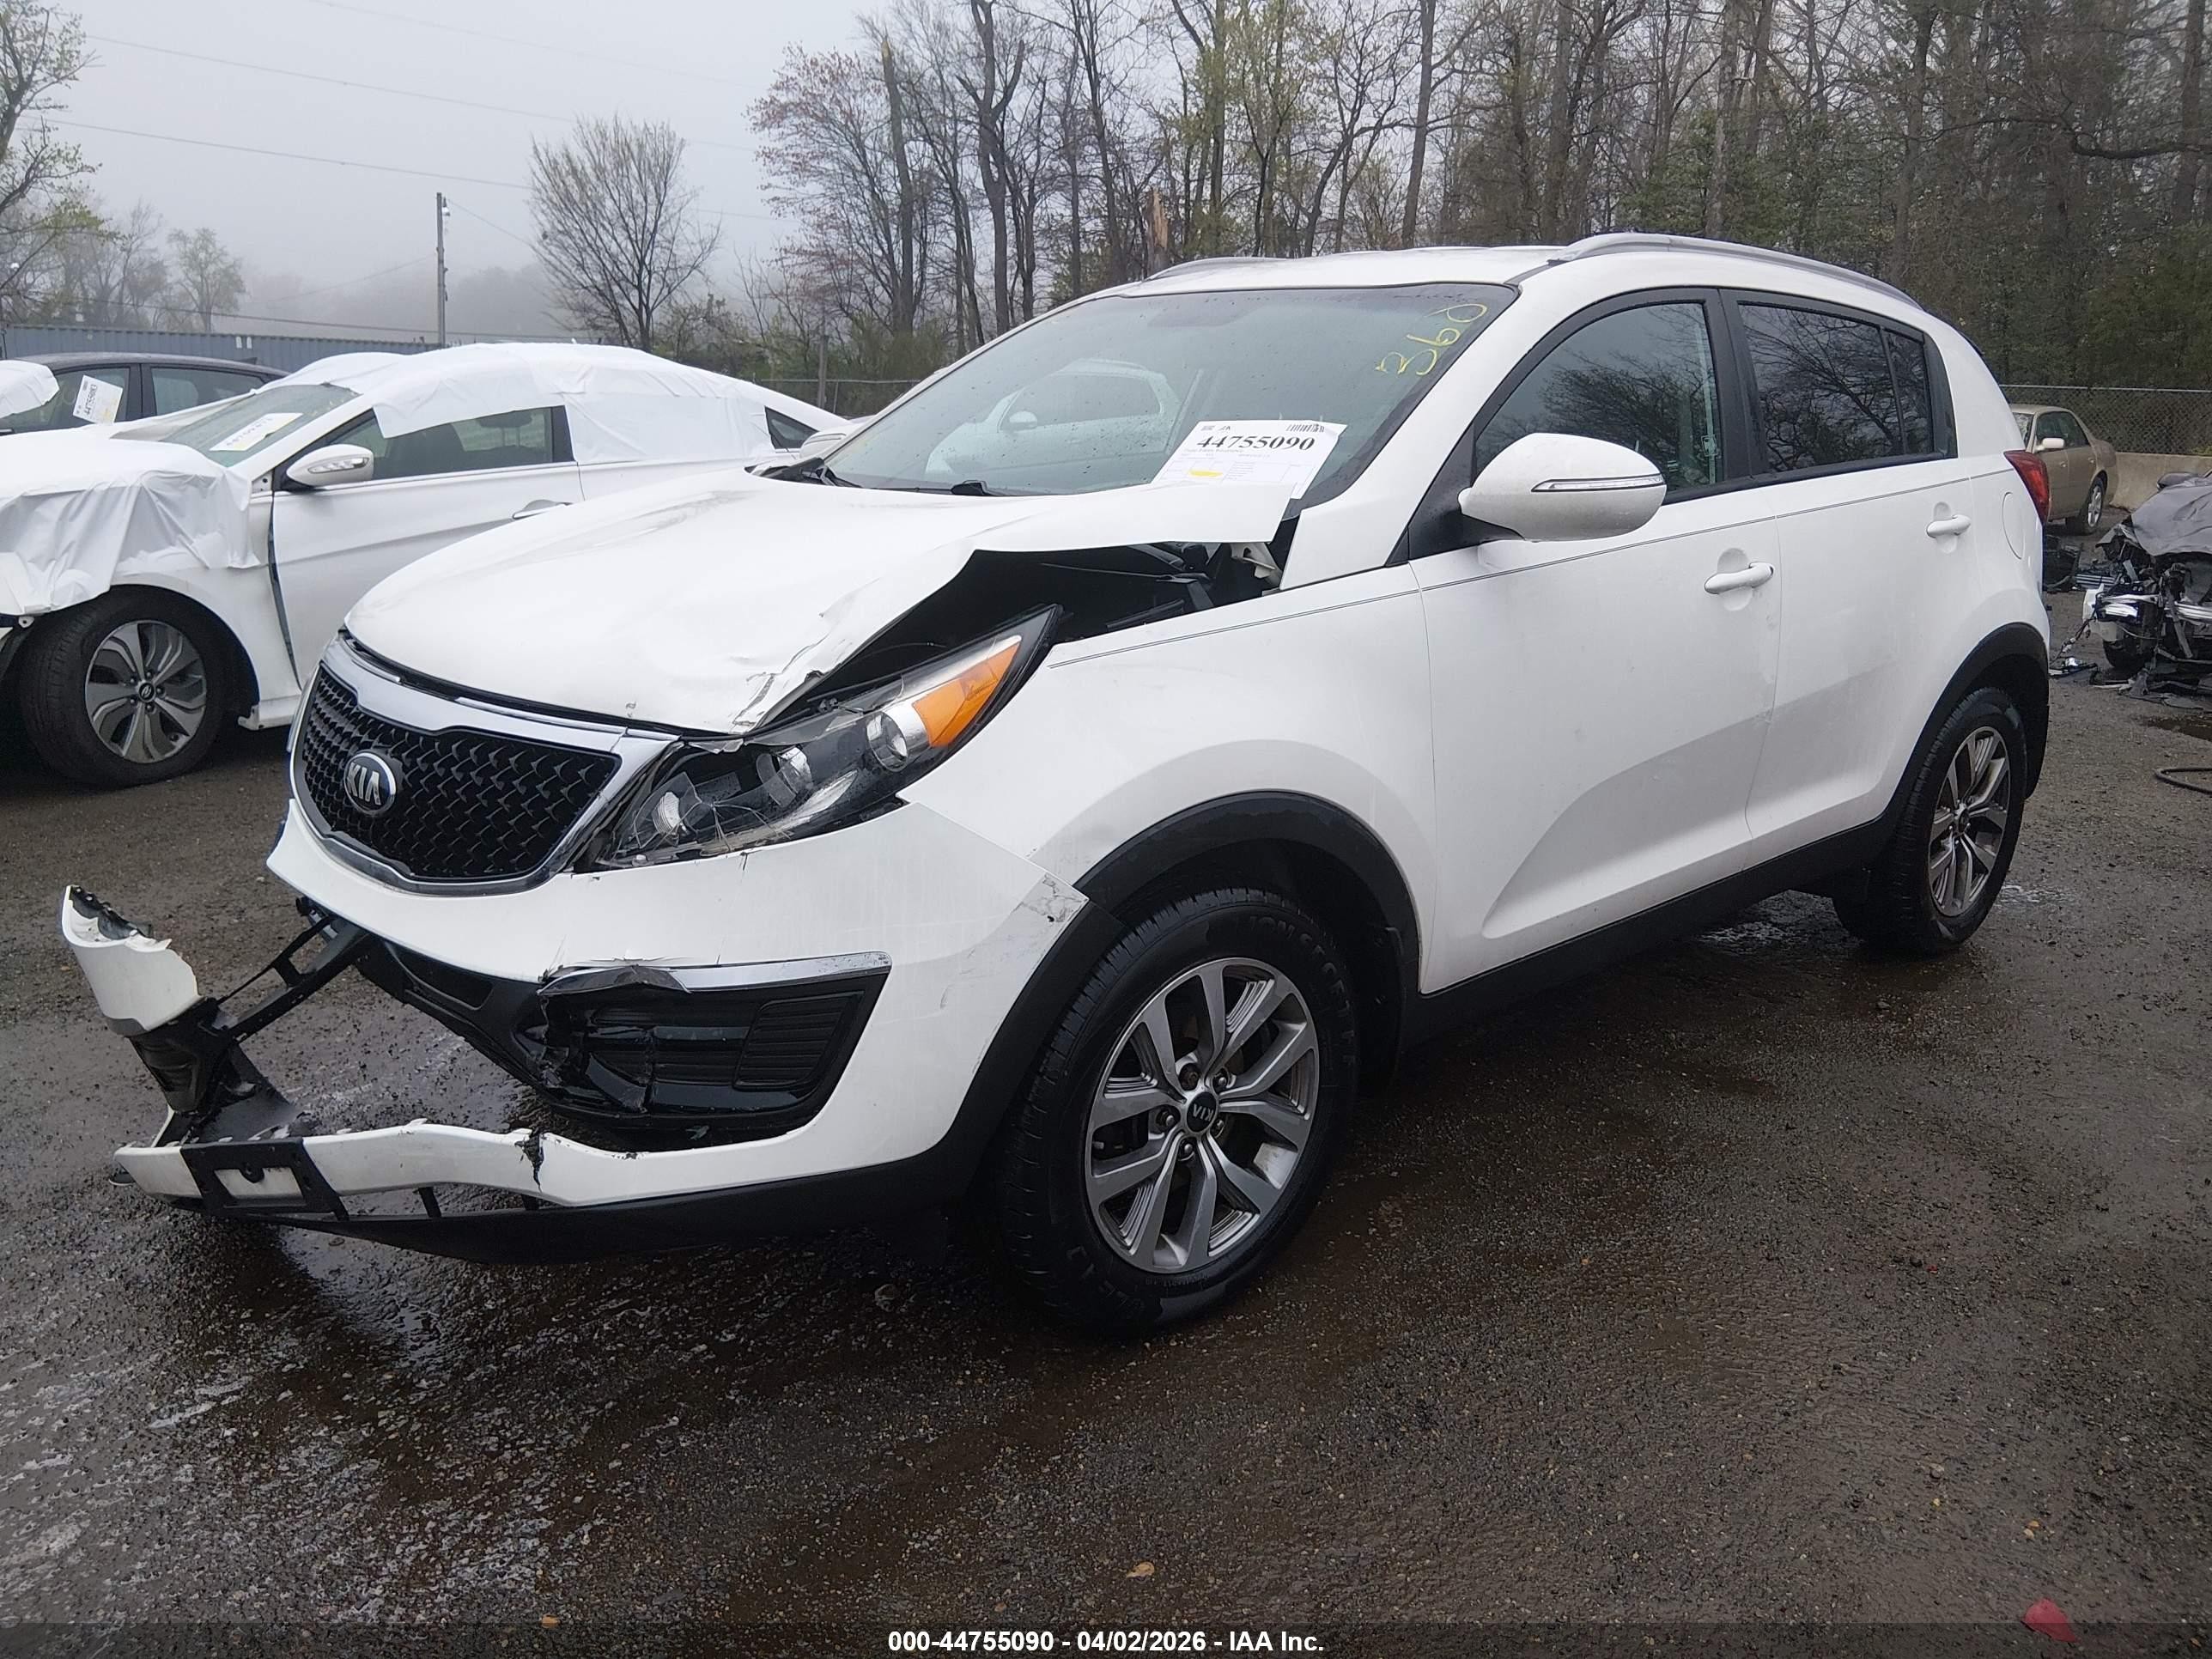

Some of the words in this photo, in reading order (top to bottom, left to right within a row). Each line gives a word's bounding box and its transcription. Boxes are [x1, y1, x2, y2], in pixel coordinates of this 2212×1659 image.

[1196, 435, 1316, 451] 44755090
[347, 762, 382, 805] KIA
[1193, 1103, 1214, 1121] KIA
